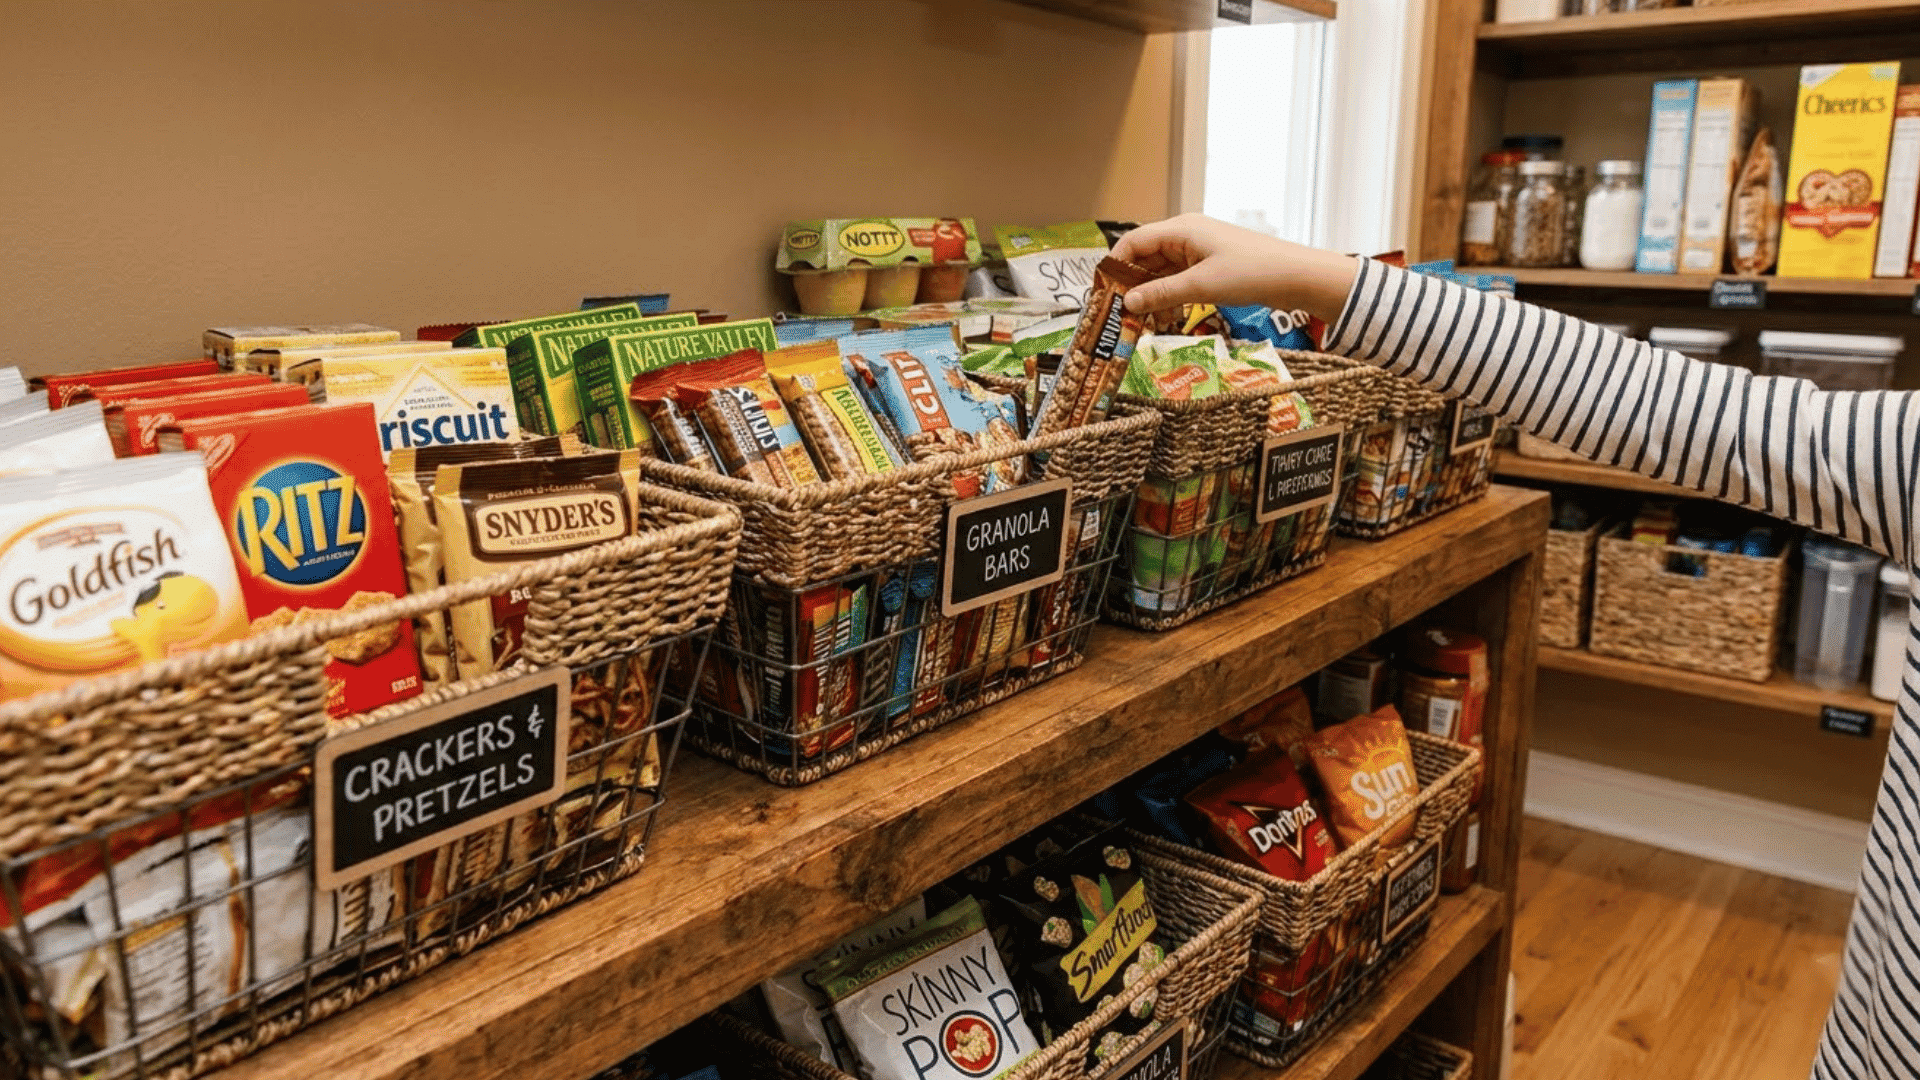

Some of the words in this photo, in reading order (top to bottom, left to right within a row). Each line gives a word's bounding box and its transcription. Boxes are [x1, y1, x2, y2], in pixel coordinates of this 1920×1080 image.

[623, 333, 703, 377] NATURE
[702, 326, 768, 354] VALLEY
[380, 401, 510, 452] riscuit
[239, 475, 364, 577] RITZ
[485, 499, 616, 540] SNYDER'S
[966, 507, 1050, 552] GRANOLA
[10, 528, 182, 626] Goldfish
[984, 545, 1031, 582] BARS
[344, 714, 516, 802] CRACKERS
[373, 753, 535, 843] PRETZELS
[1350, 761, 1412, 820] Sun
[882, 946, 996, 1036] SKINNY
